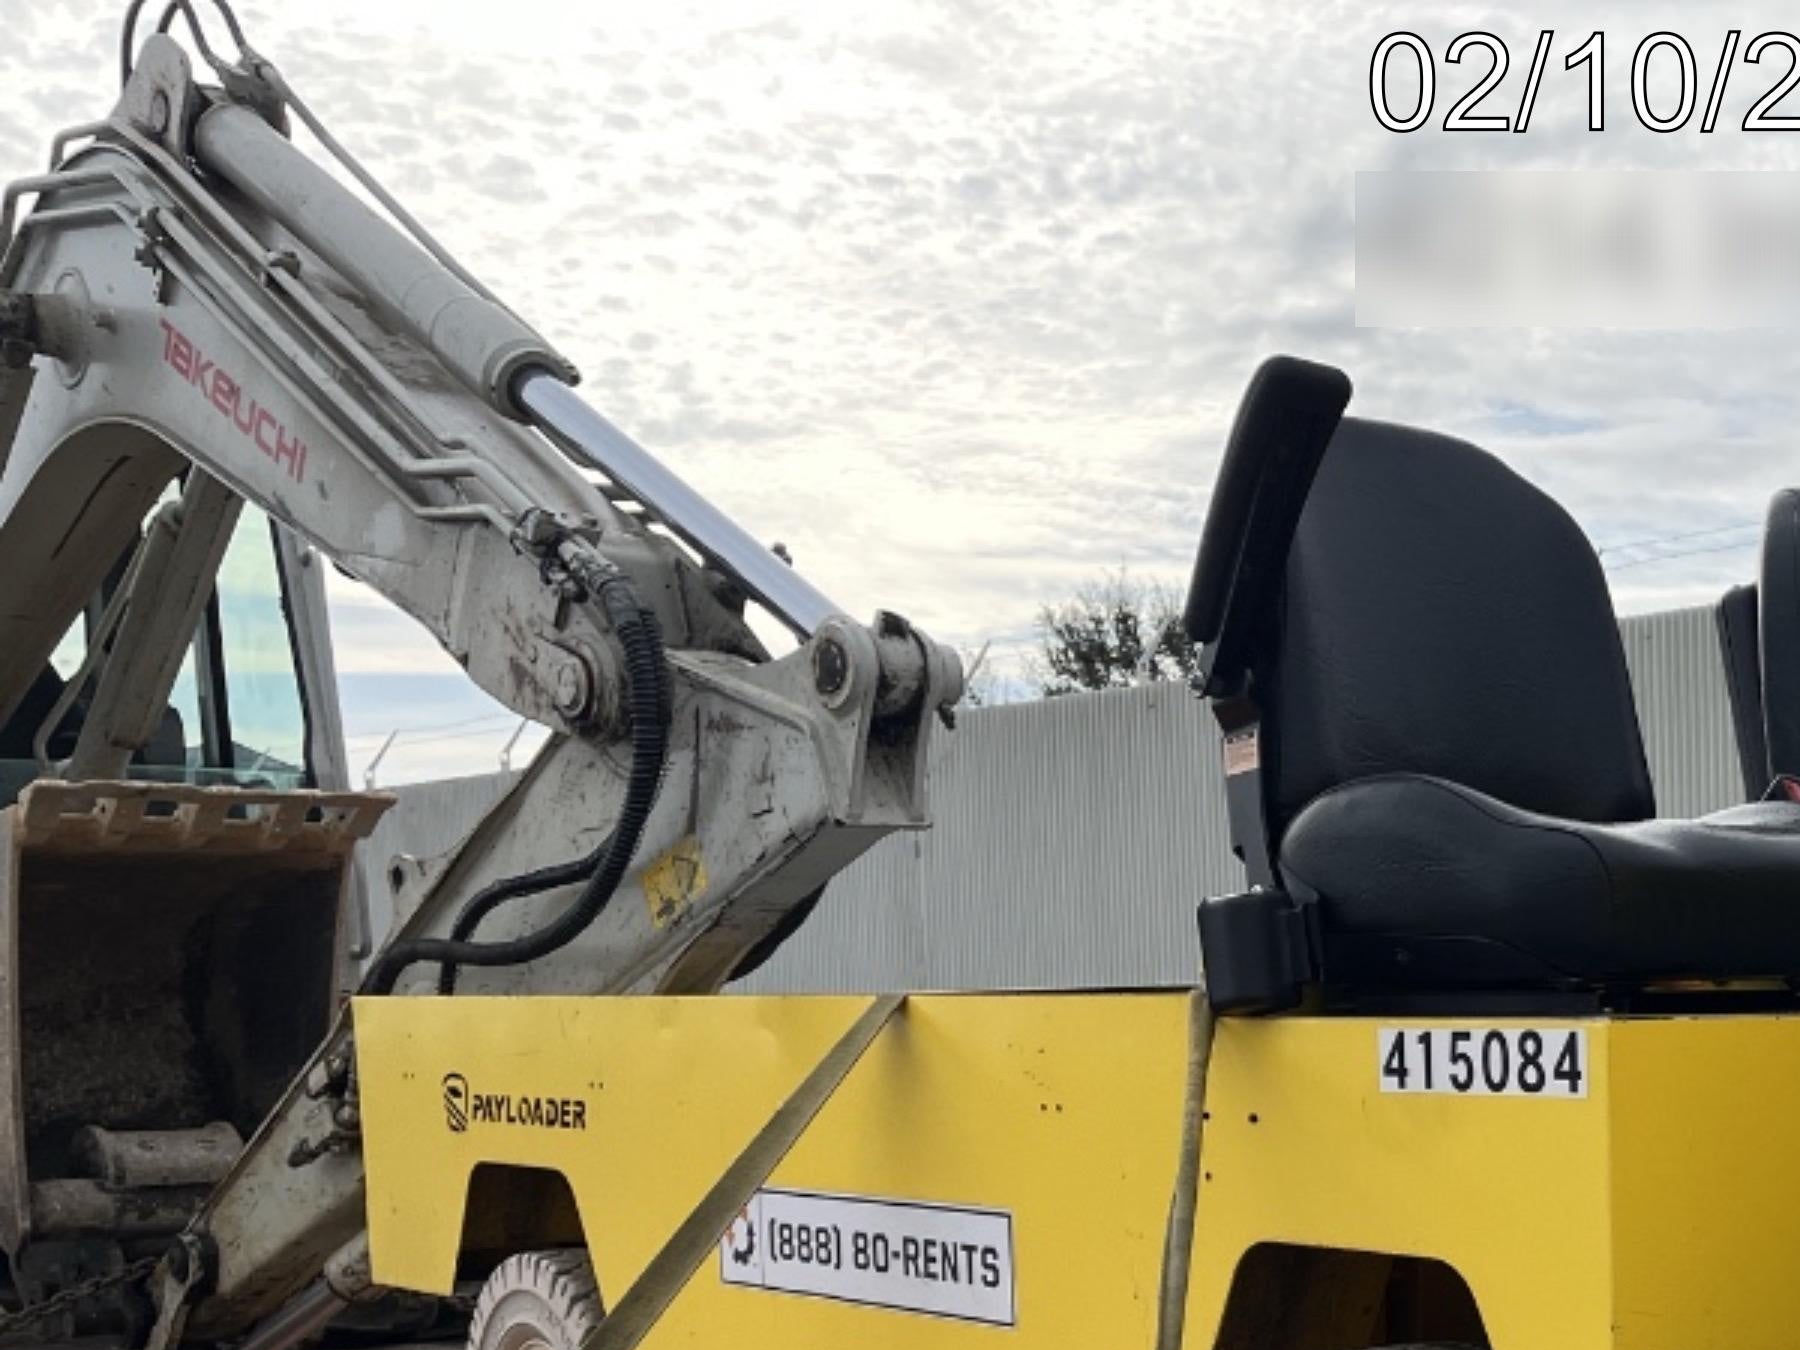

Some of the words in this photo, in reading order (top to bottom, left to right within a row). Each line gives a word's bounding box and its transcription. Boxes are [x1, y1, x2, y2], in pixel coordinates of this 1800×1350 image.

[1382, 1029, 1583, 1093] 415084
[472, 1093, 587, 1130] PAYLOADER
[767, 1217, 842, 1269] (888)
[853, 1230, 1001, 1289] 80-RENTS
